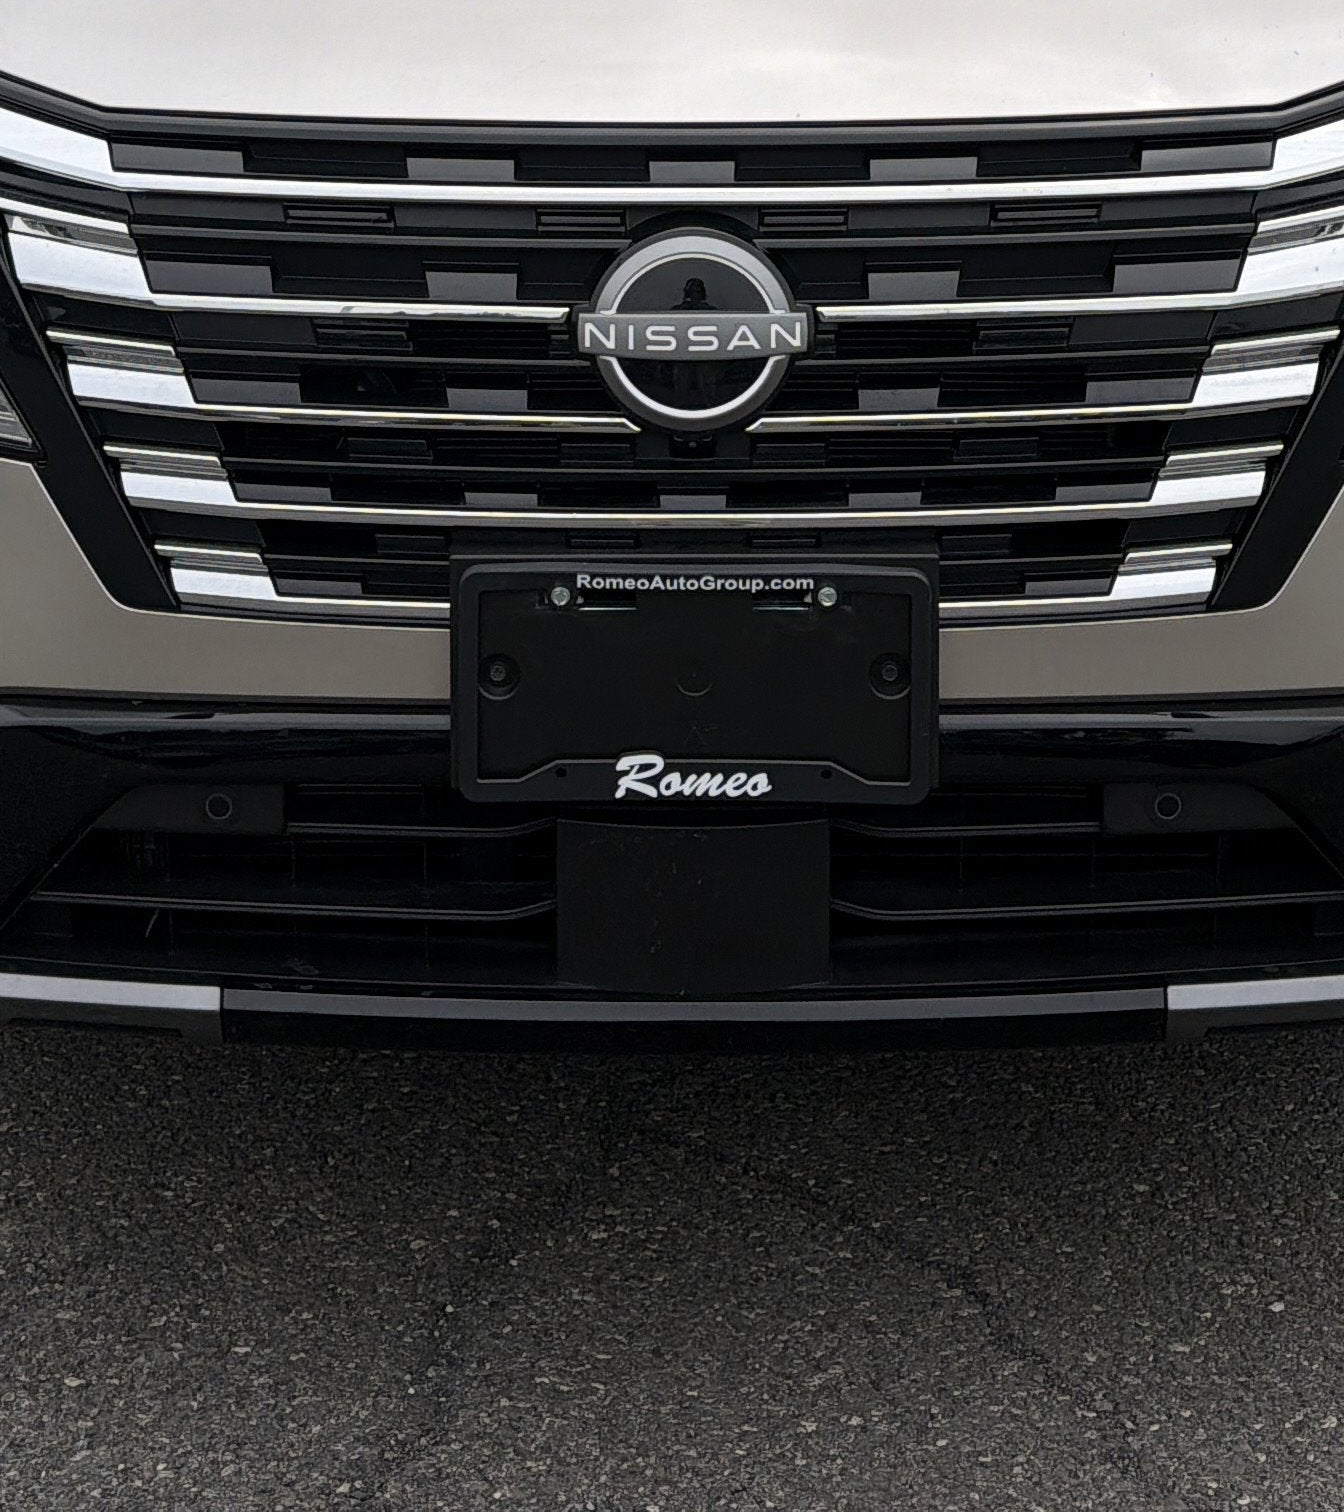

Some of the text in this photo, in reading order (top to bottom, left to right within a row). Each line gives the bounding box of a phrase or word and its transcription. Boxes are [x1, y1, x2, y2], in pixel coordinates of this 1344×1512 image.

[584, 321, 802, 352] NISSAN
[576, 574, 815, 593] RomeoAutoGroup.com
[614, 753, 773, 800] Romeo
